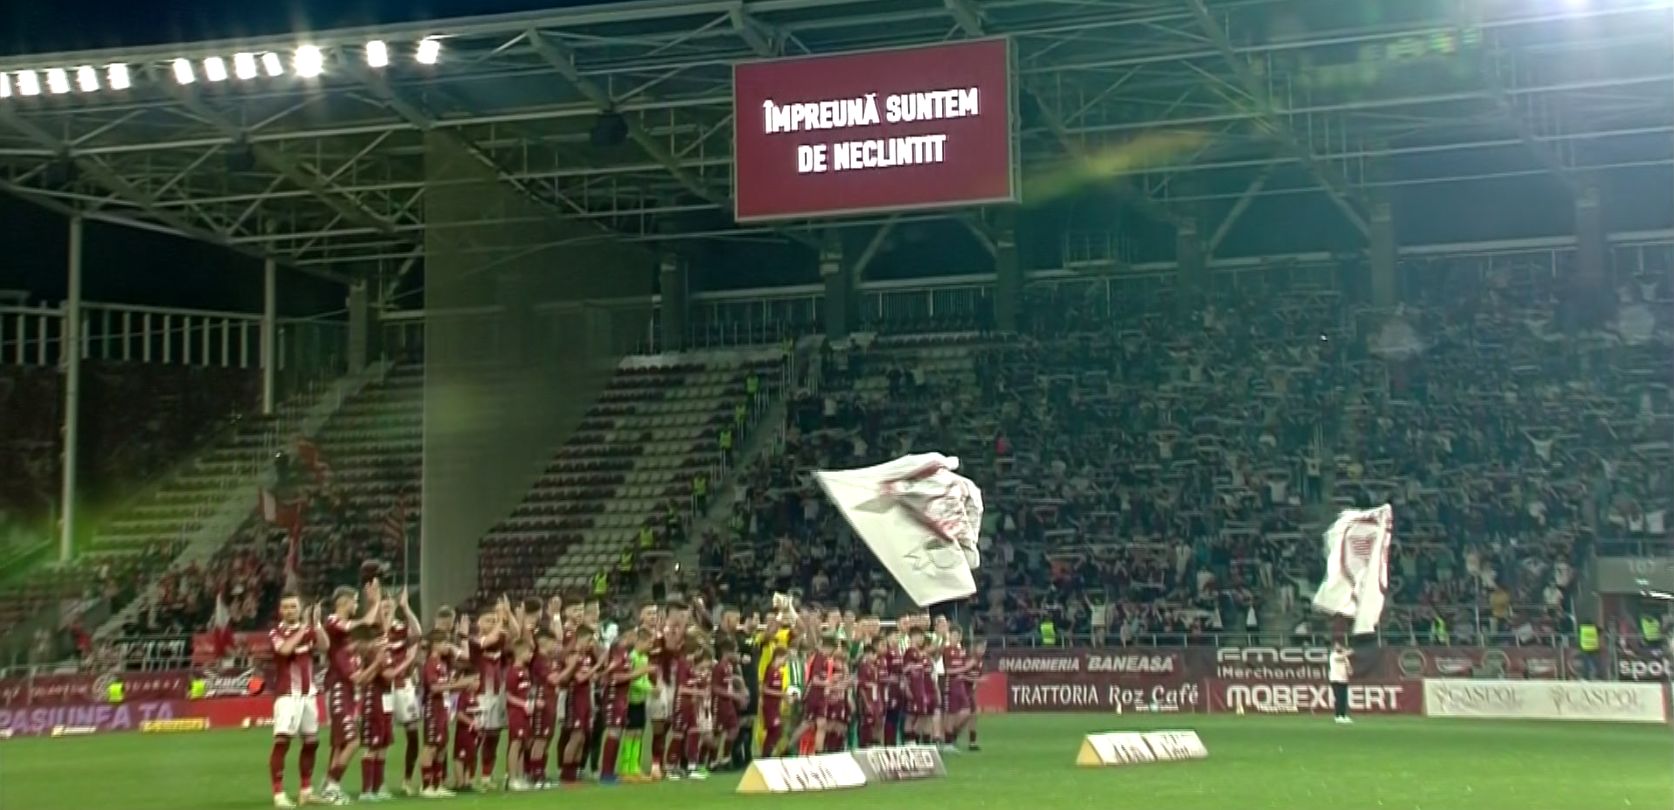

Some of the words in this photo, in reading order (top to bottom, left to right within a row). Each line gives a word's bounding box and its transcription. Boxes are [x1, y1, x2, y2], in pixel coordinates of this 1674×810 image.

[763, 92, 880, 134] ÎMPREUNĂ
[886, 87, 979, 123] SUNTEM
[798, 144, 828, 173] DE
[834, 134, 947, 171] NECLINTIT
[1011, 684, 1099, 706] TRATTORIA
[1109, 684, 1144, 706] Roz
[1152, 682, 1199, 706] Café
